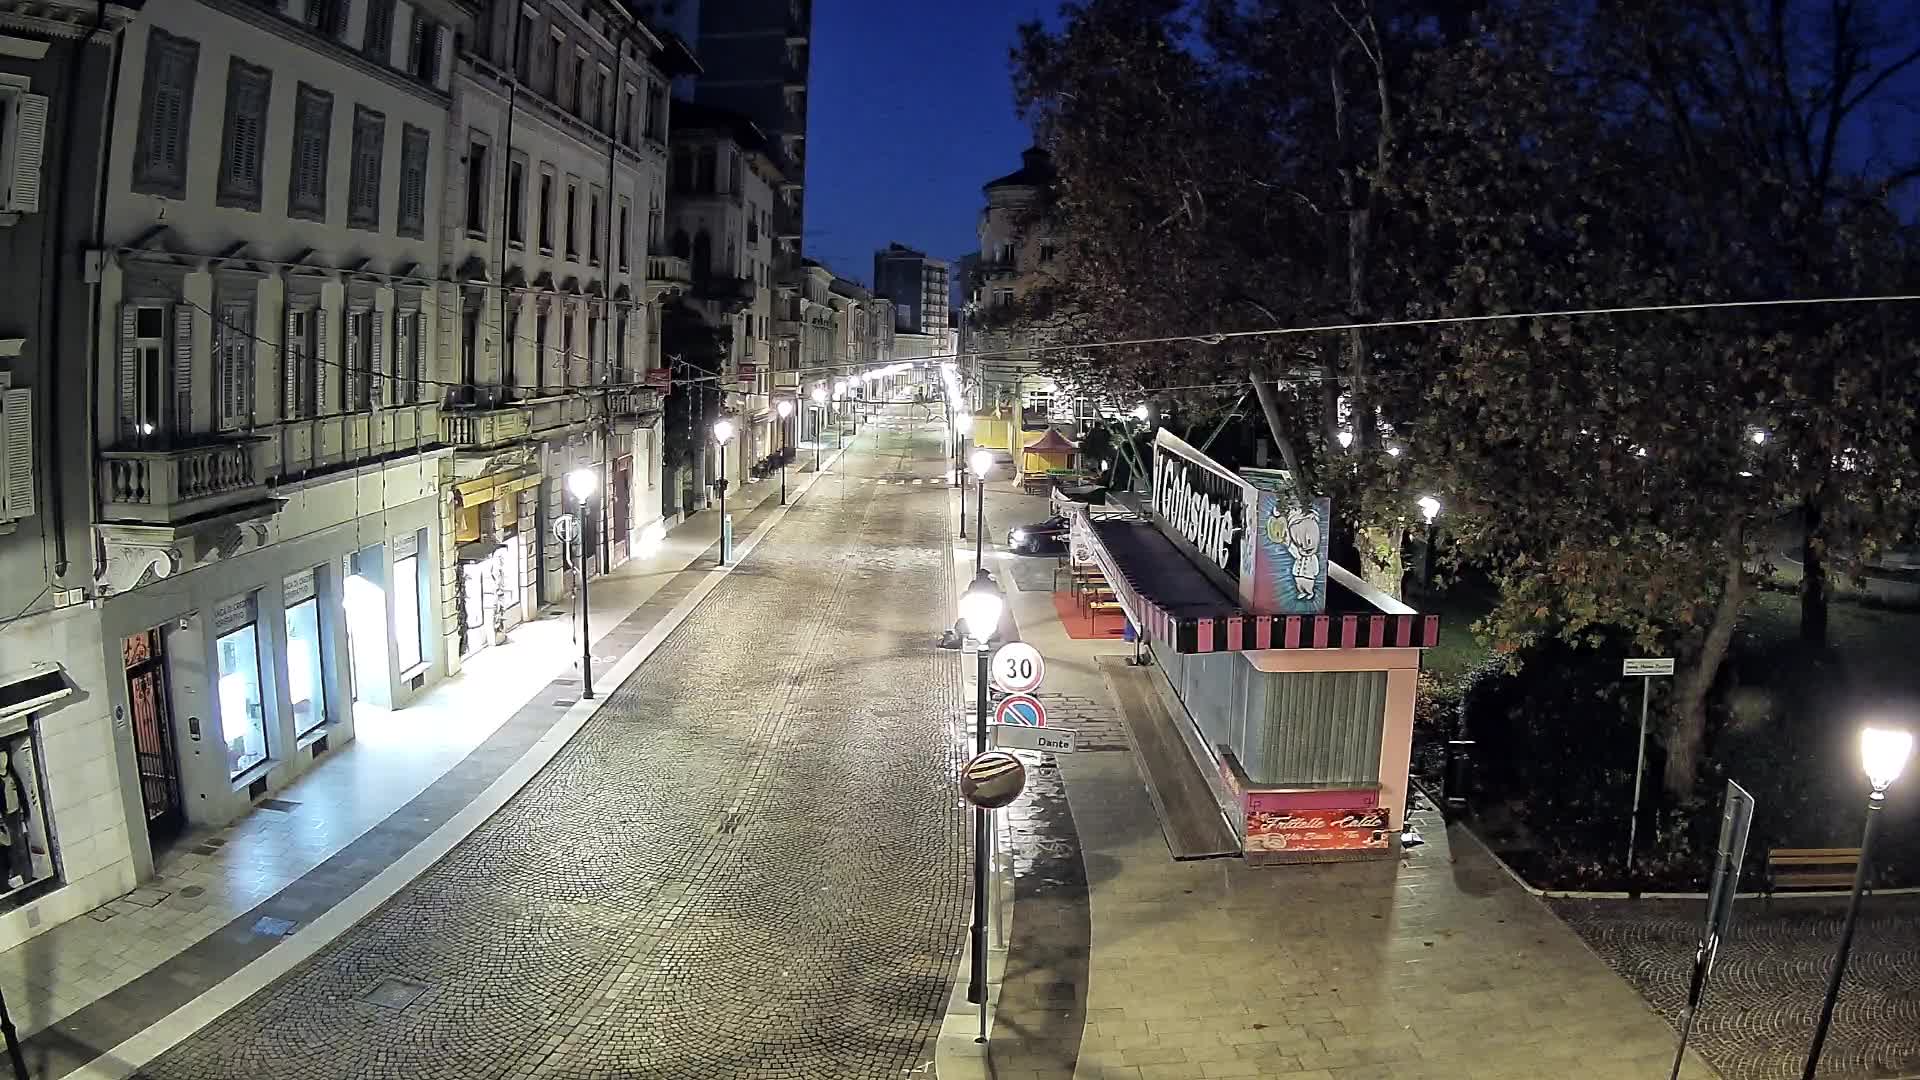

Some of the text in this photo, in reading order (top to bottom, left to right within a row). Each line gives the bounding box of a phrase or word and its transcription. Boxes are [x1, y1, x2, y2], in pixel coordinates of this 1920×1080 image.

[1162, 459, 1233, 570] Golosone
[1006, 658, 1032, 679] 30
[1038, 737, 1069, 748] Dante
